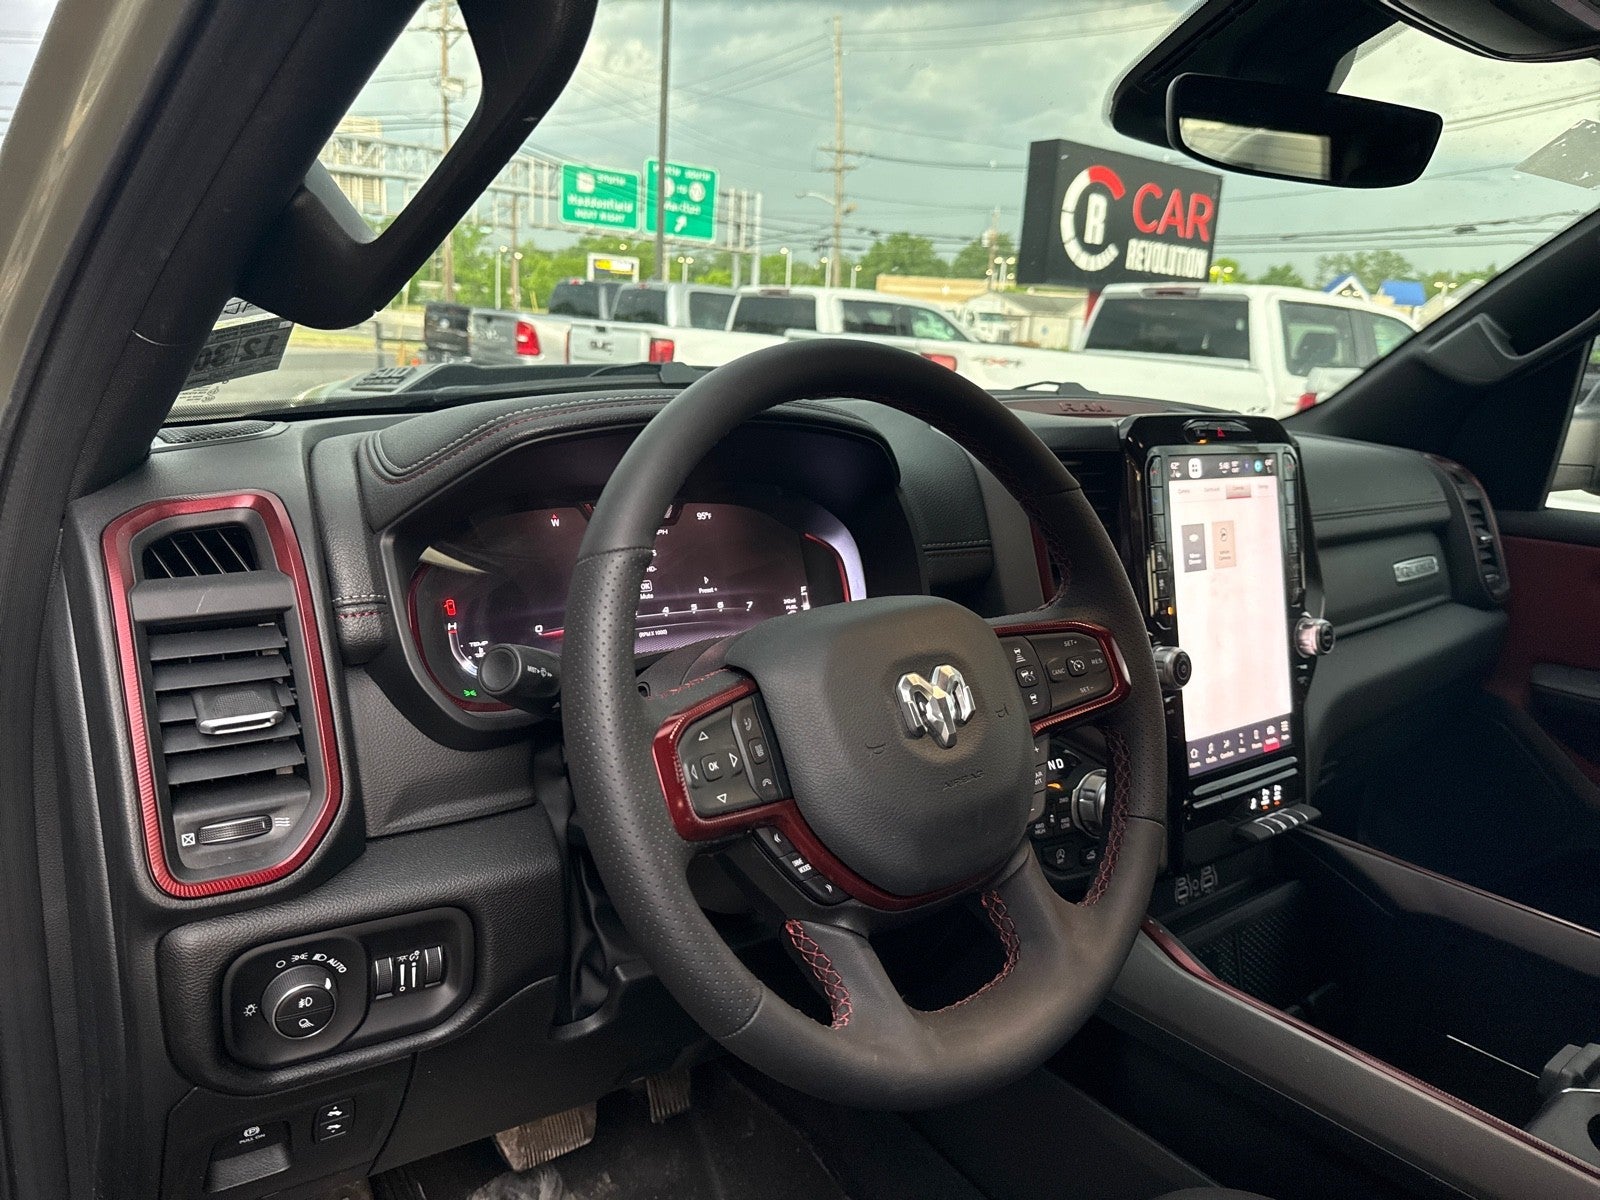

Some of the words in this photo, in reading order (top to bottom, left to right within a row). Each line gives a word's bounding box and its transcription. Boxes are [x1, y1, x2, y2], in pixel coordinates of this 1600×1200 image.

[1132, 182, 1215, 243] CAR
[1125, 238, 1209, 279] REVOLUTION
[550, 518, 560, 527] W
[640, 583, 651, 591] OK
[717, 601, 725, 609] 6
[746, 601, 754, 609] 7
[661, 606, 670, 614] 4
[447, 622, 457, 630] H
[468, 640, 489, 648] TEMP
[708, 761, 719, 771] OK
[327, 957, 348, 974] AUTO
[238, 1136, 254, 1144] PULL
